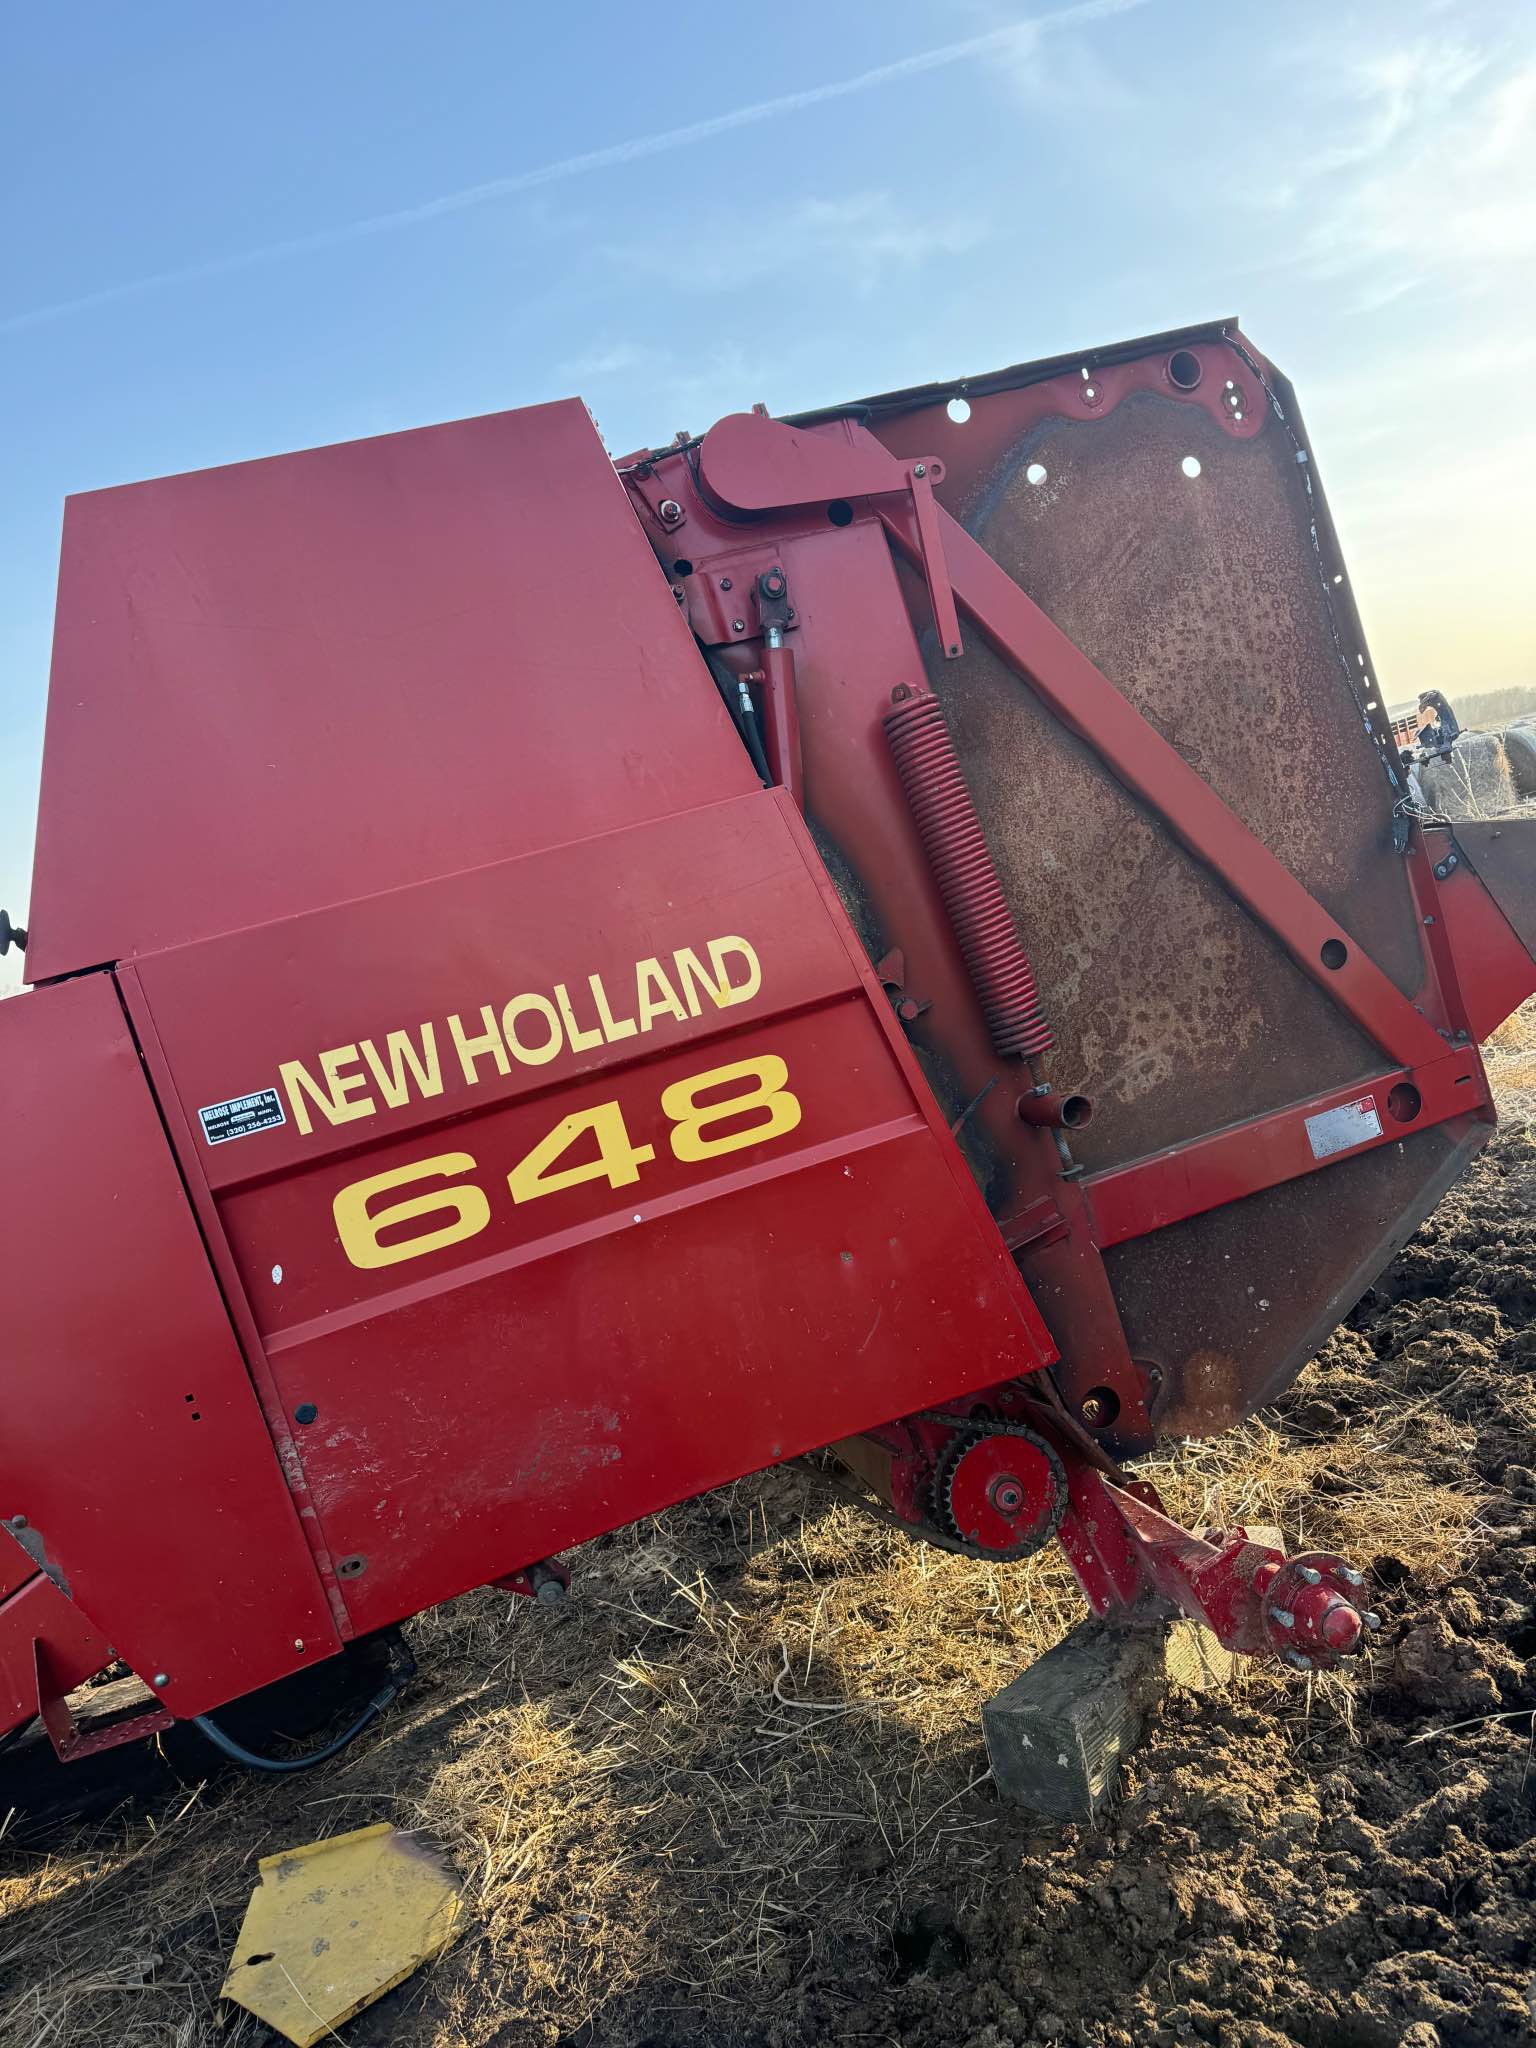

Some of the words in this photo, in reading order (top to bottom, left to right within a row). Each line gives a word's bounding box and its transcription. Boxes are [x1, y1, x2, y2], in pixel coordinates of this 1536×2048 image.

[279, 1022, 444, 1136] NEW
[448, 935, 762, 1085] HOLLAND
[203, 1105, 230, 1122] MELROSE
[229, 1095, 264, 1114] IMPLEMENT,
[263, 1094, 276, 1104] Inc.
[207, 1120, 230, 1131] MELROSE
[226, 1125, 246, 1137] (320)
[247, 1114, 282, 1130] 256-4253
[332, 1054, 802, 1270] 648
